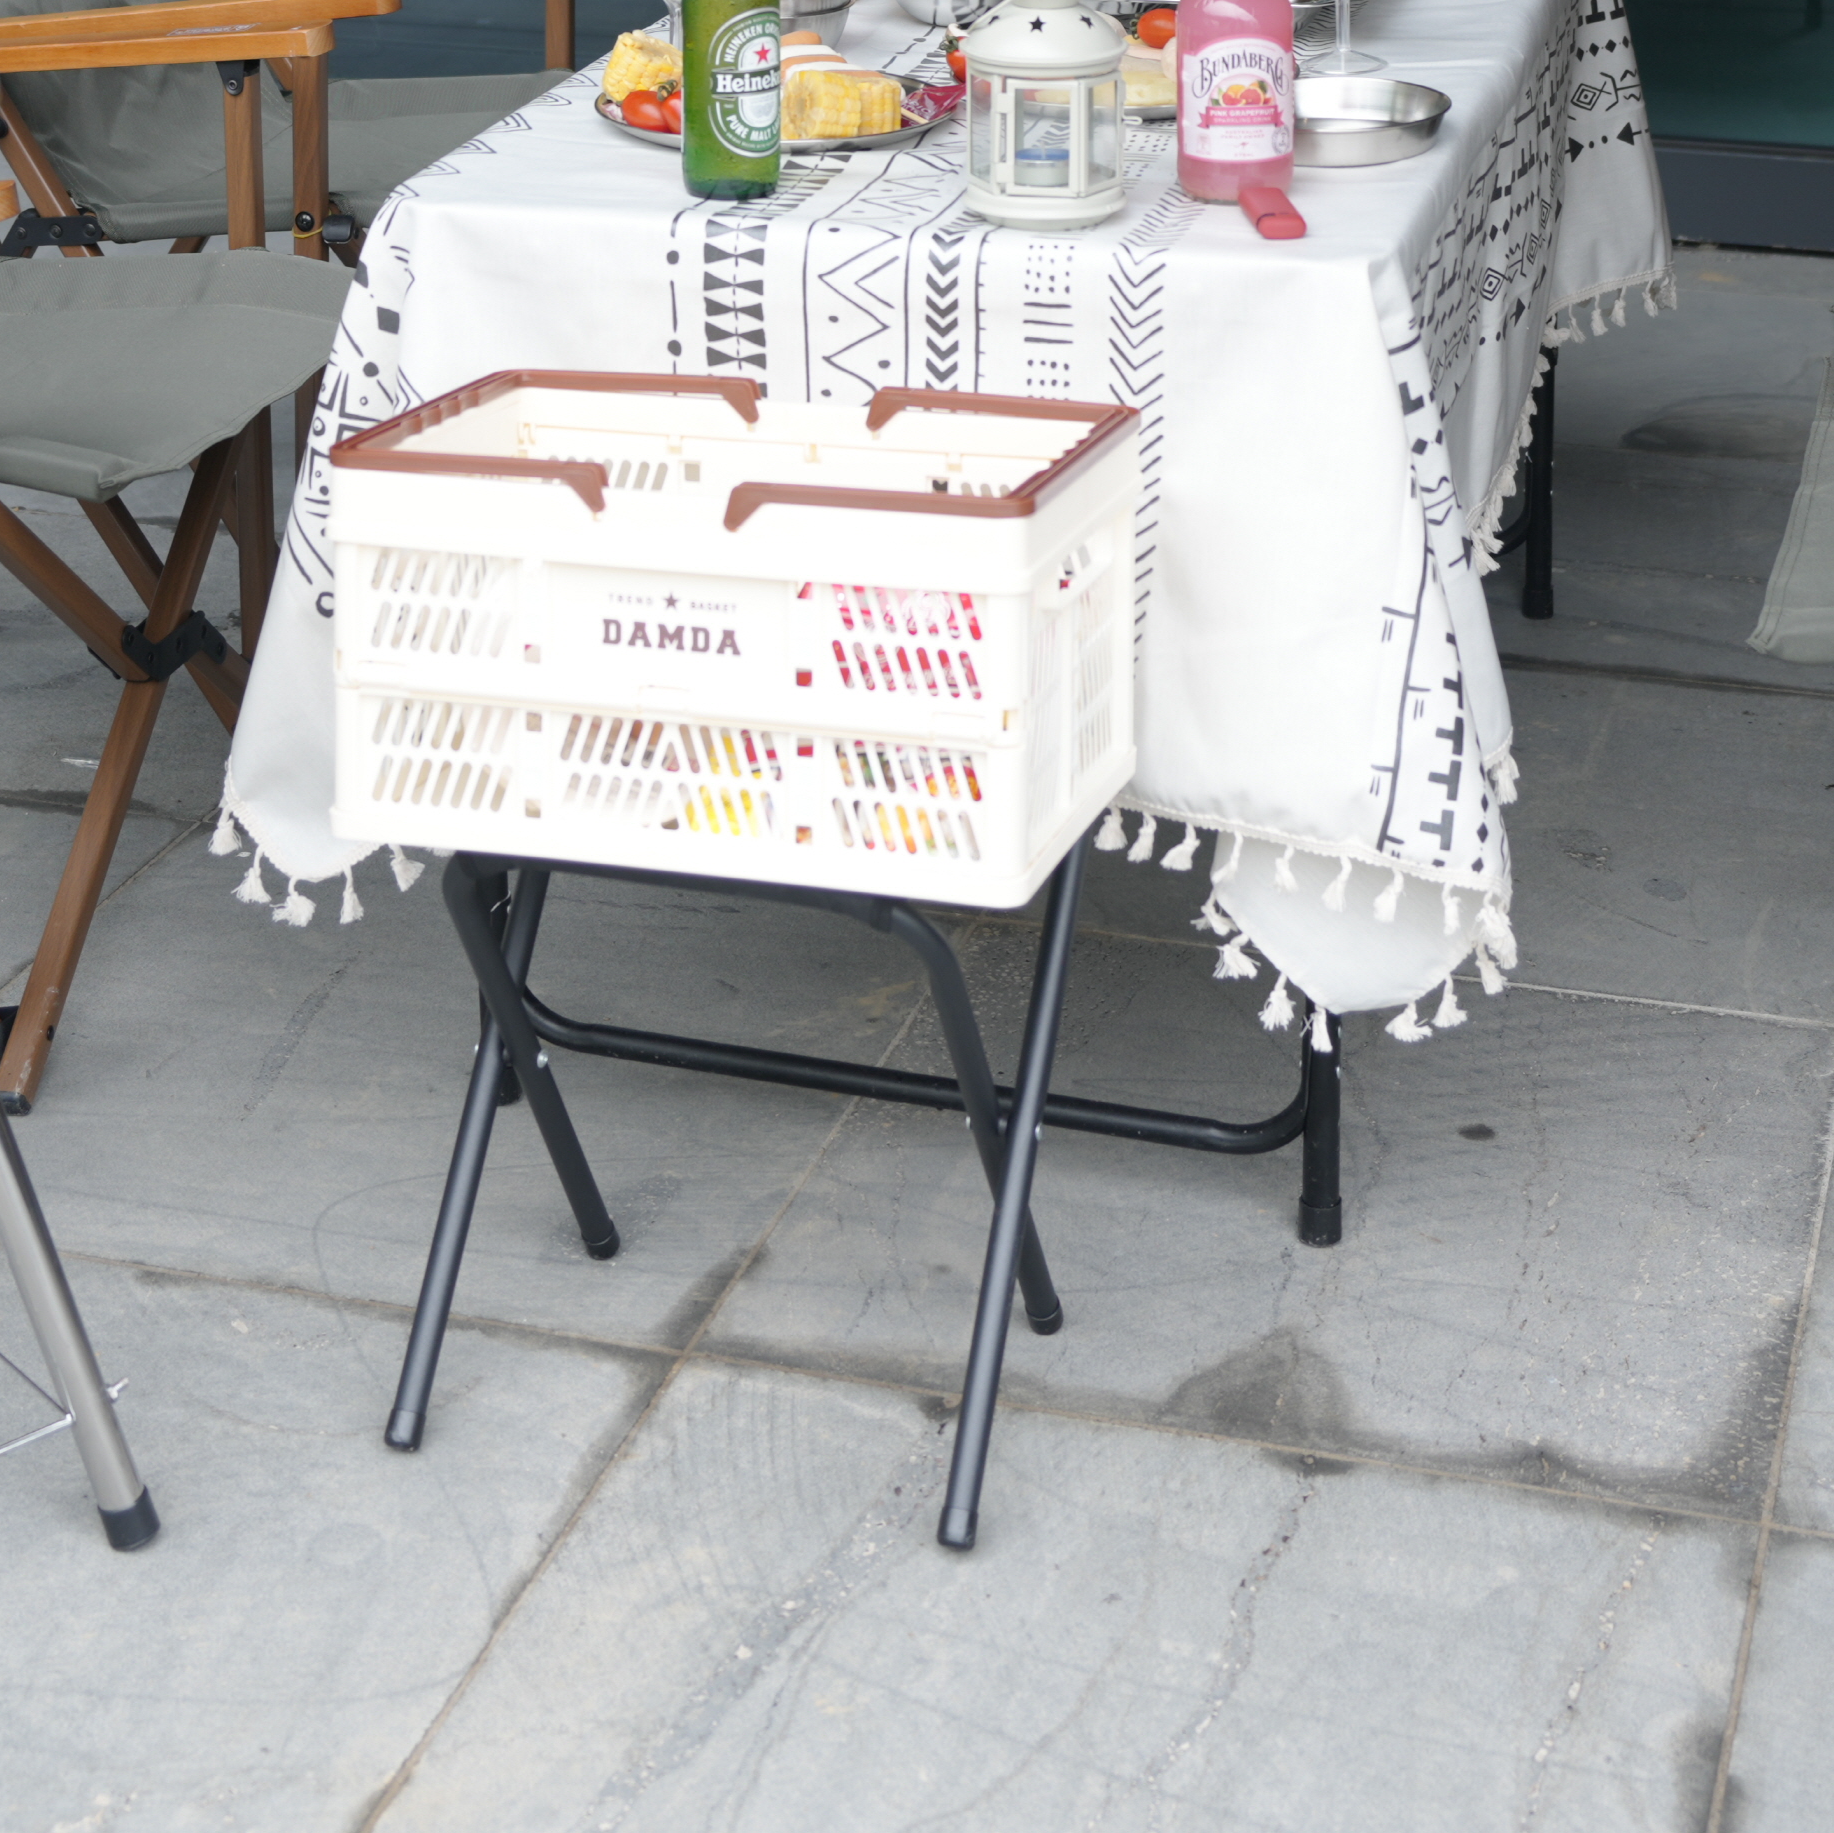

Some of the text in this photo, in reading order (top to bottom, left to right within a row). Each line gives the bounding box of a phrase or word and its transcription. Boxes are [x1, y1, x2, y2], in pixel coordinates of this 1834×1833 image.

[724, 24, 763, 63] HEINEKEN
[716, 69, 780, 93] Heinek
[1192, 48, 1289, 98] BUNDABERG
[726, 114, 749, 139] PURE
[750, 128, 771, 141] MALT
[1210, 109, 1228, 117] PINK
[603, 619, 741, 655] DAMDA
